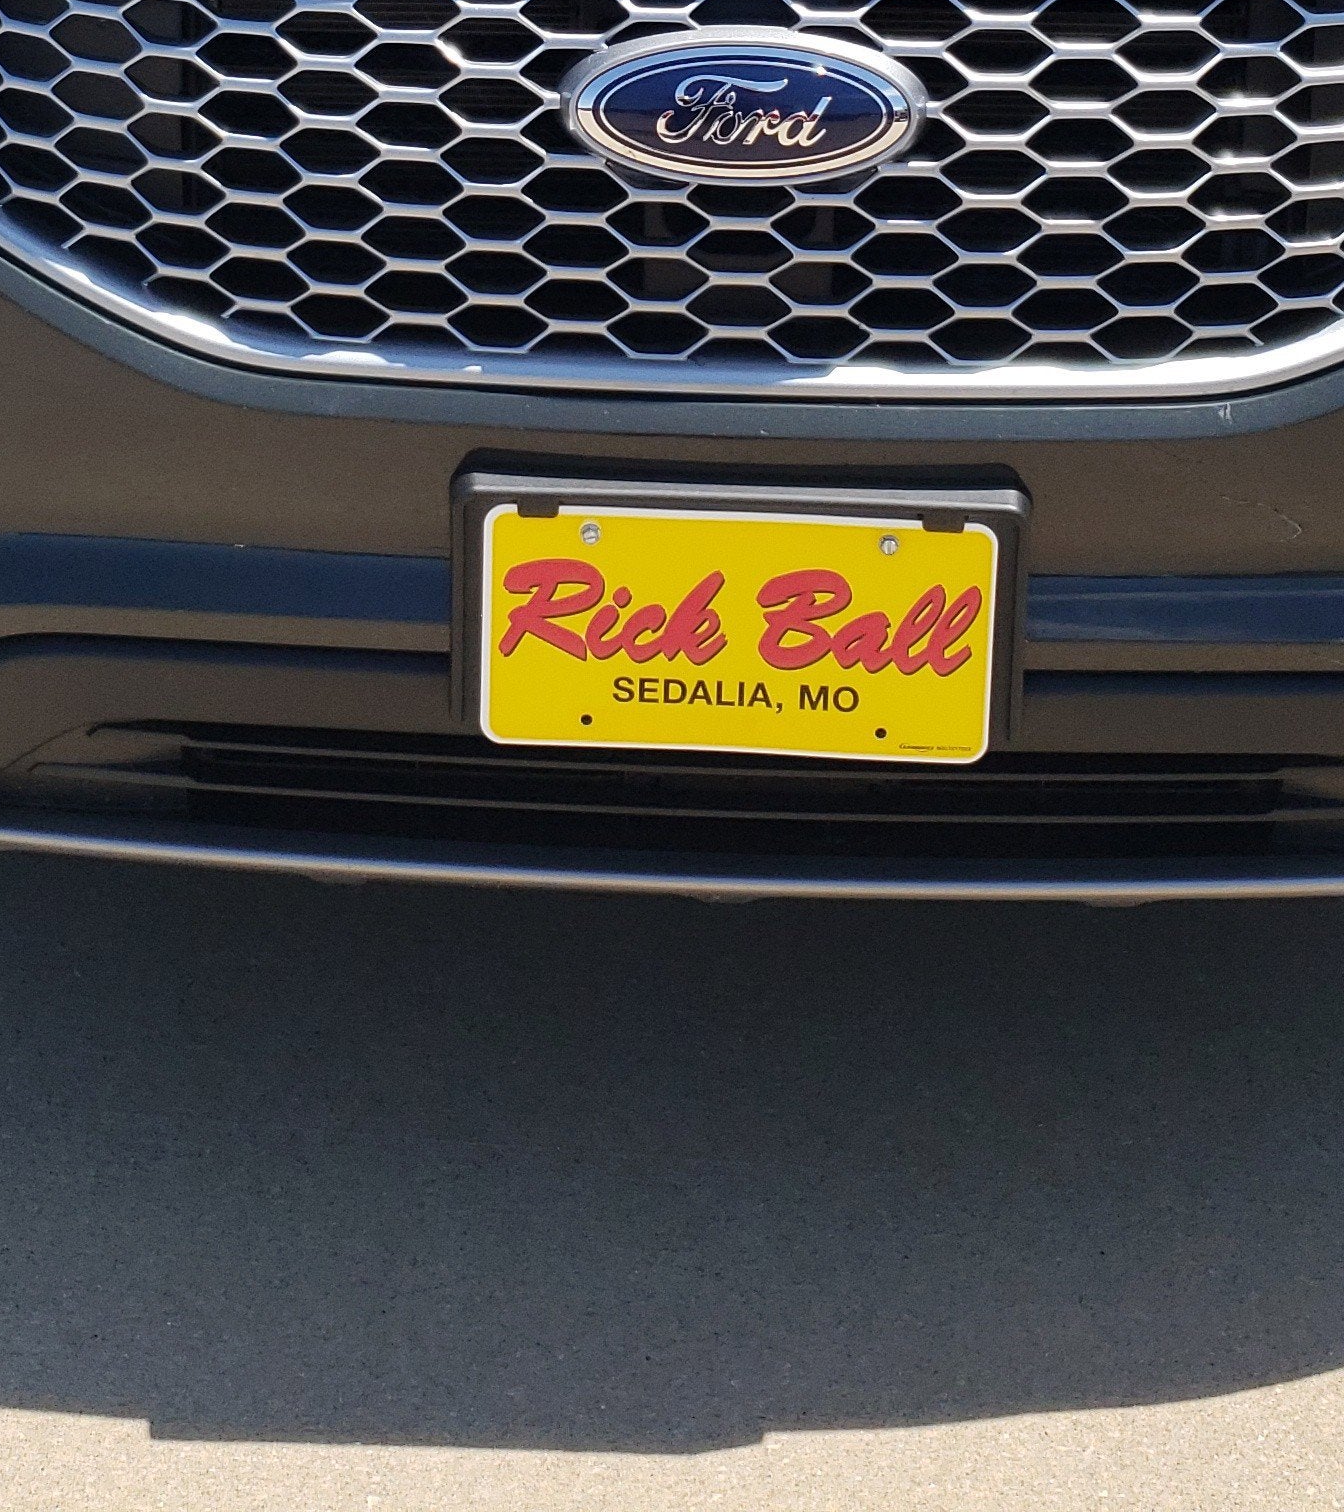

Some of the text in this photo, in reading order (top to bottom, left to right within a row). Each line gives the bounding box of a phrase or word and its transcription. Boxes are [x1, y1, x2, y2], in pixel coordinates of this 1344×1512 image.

[656, 74, 833, 147] Ford
[498, 557, 982, 677] Rick Ball
[612, 676, 861, 715] SEDALIA, MO
